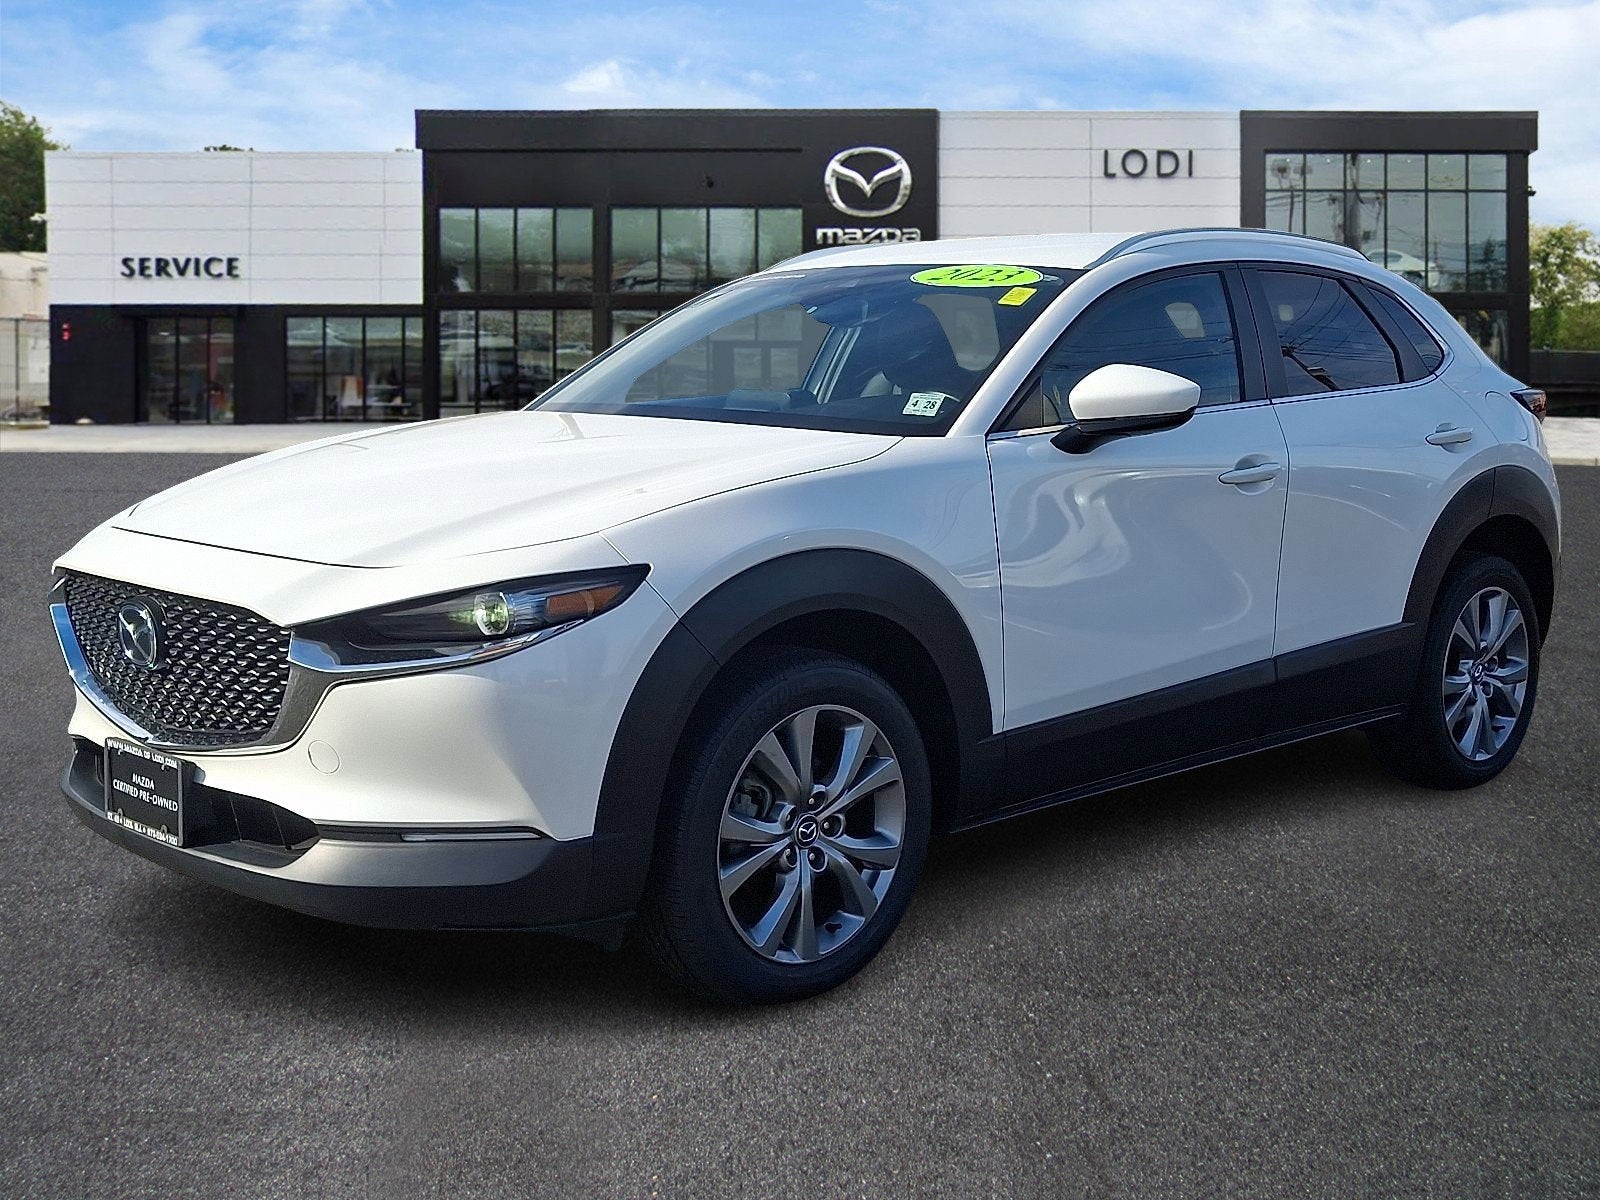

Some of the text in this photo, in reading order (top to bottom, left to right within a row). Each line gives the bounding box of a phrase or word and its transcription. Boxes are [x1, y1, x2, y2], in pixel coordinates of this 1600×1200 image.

[1103, 149, 1193, 178] LODI
[120, 257, 240, 278] SERVICE
[911, 399, 938, 410] 4 28
[132, 773, 155, 790] MAZDA
[112, 779, 178, 812] CERTIFIED PRE-OWNED
